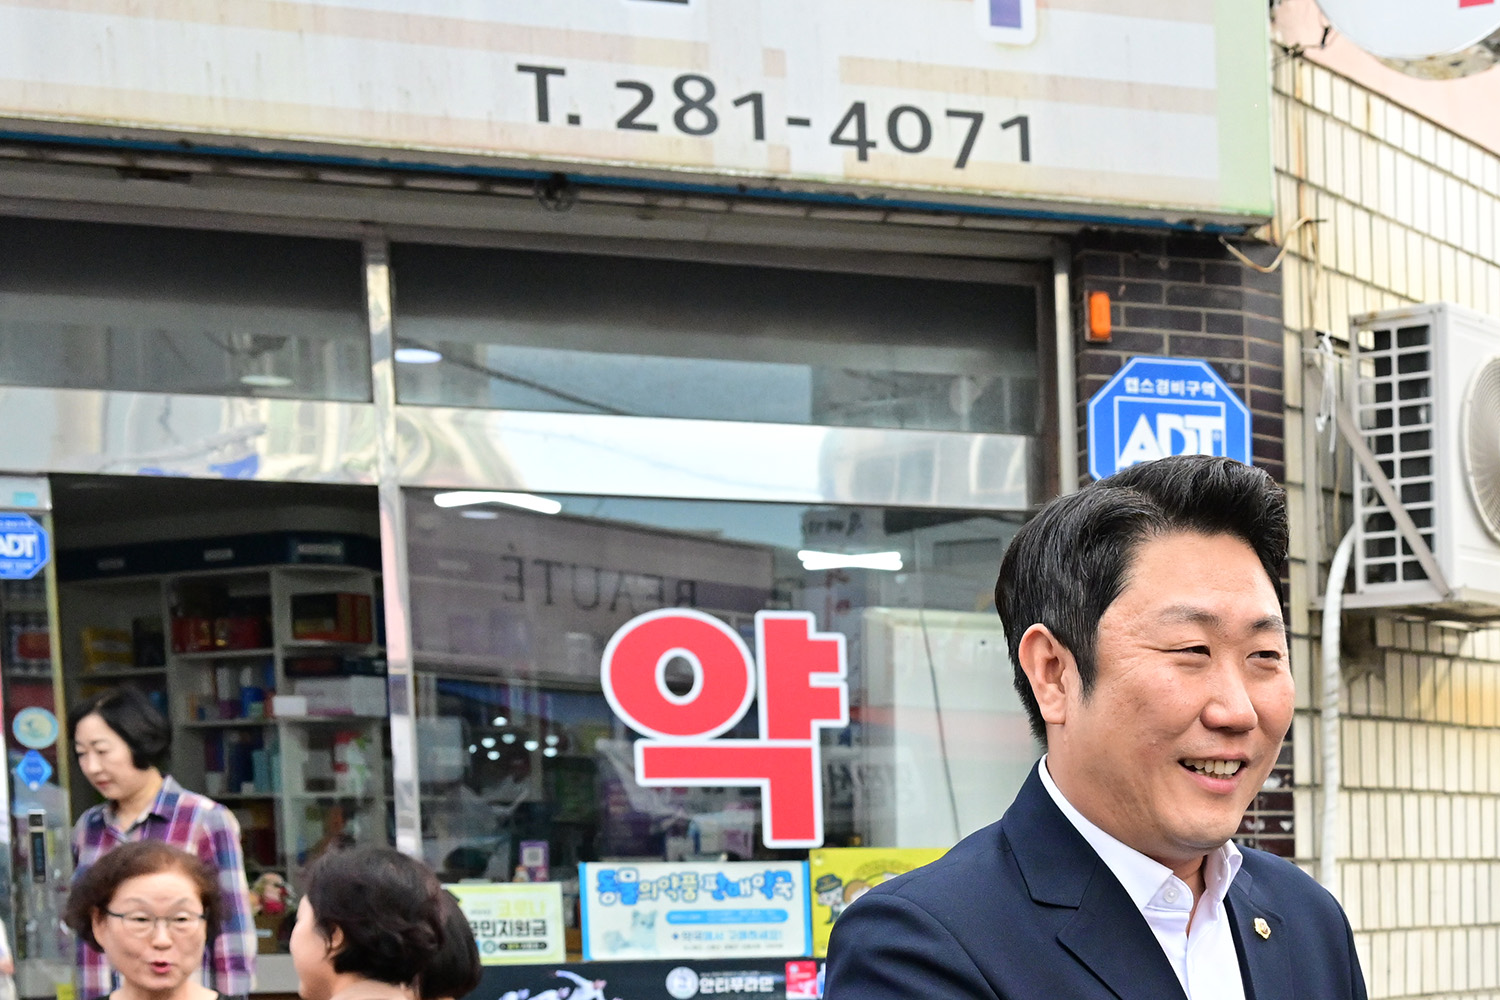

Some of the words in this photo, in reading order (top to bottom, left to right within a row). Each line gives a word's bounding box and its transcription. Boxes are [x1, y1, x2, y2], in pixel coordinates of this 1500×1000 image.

[516, 63, 583, 127] T.
[614, 73, 1032, 169] 281-4071
[1115, 413, 1226, 474] ADT
[601, 608, 850, 849] 약
[596, 867, 700, 906] 동물의약품
[701, 869, 794, 901] 판매약국
